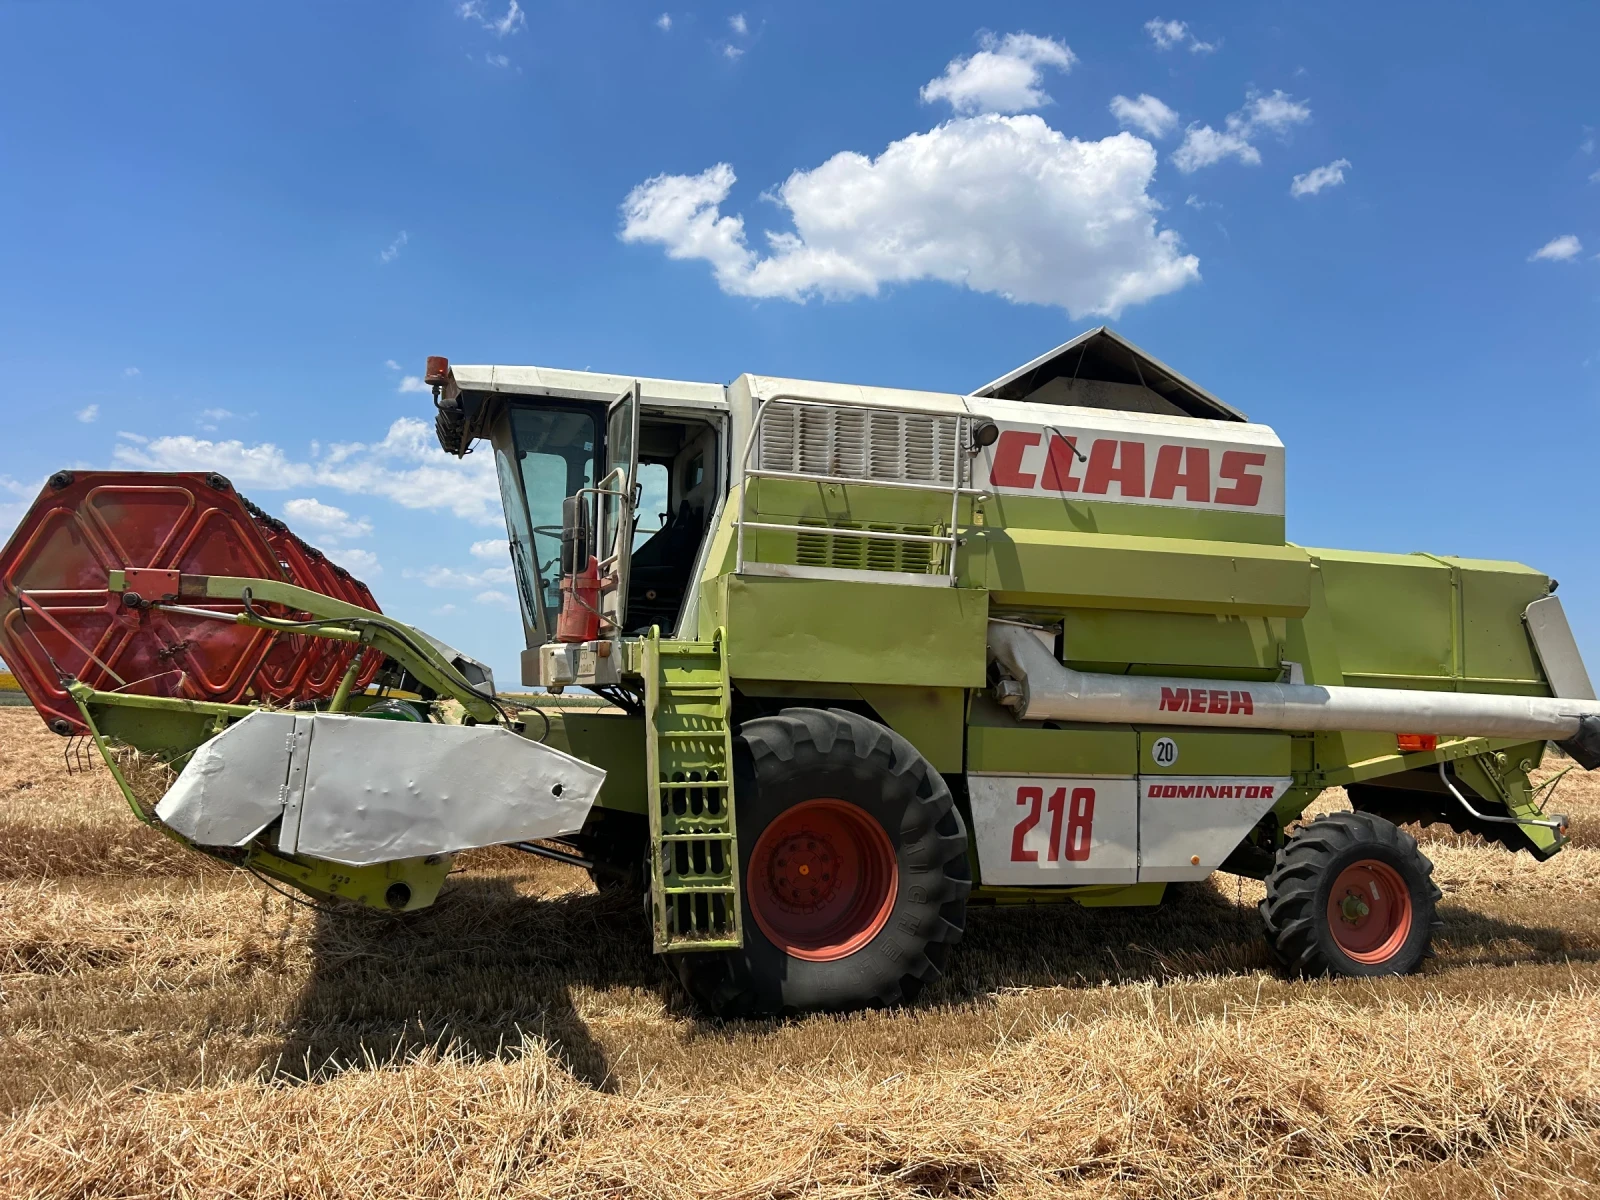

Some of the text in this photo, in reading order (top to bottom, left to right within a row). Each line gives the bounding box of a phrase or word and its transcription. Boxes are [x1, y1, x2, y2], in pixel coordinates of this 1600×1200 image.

[989, 430, 1267, 507] CLAAS
[1159, 686, 1254, 716] MEGA
[1157, 741, 1174, 762] 20
[1147, 784, 1275, 799] DOMINATOR
[1010, 786, 1096, 862] 218
[817, 827, 928, 990] MICHELIN
